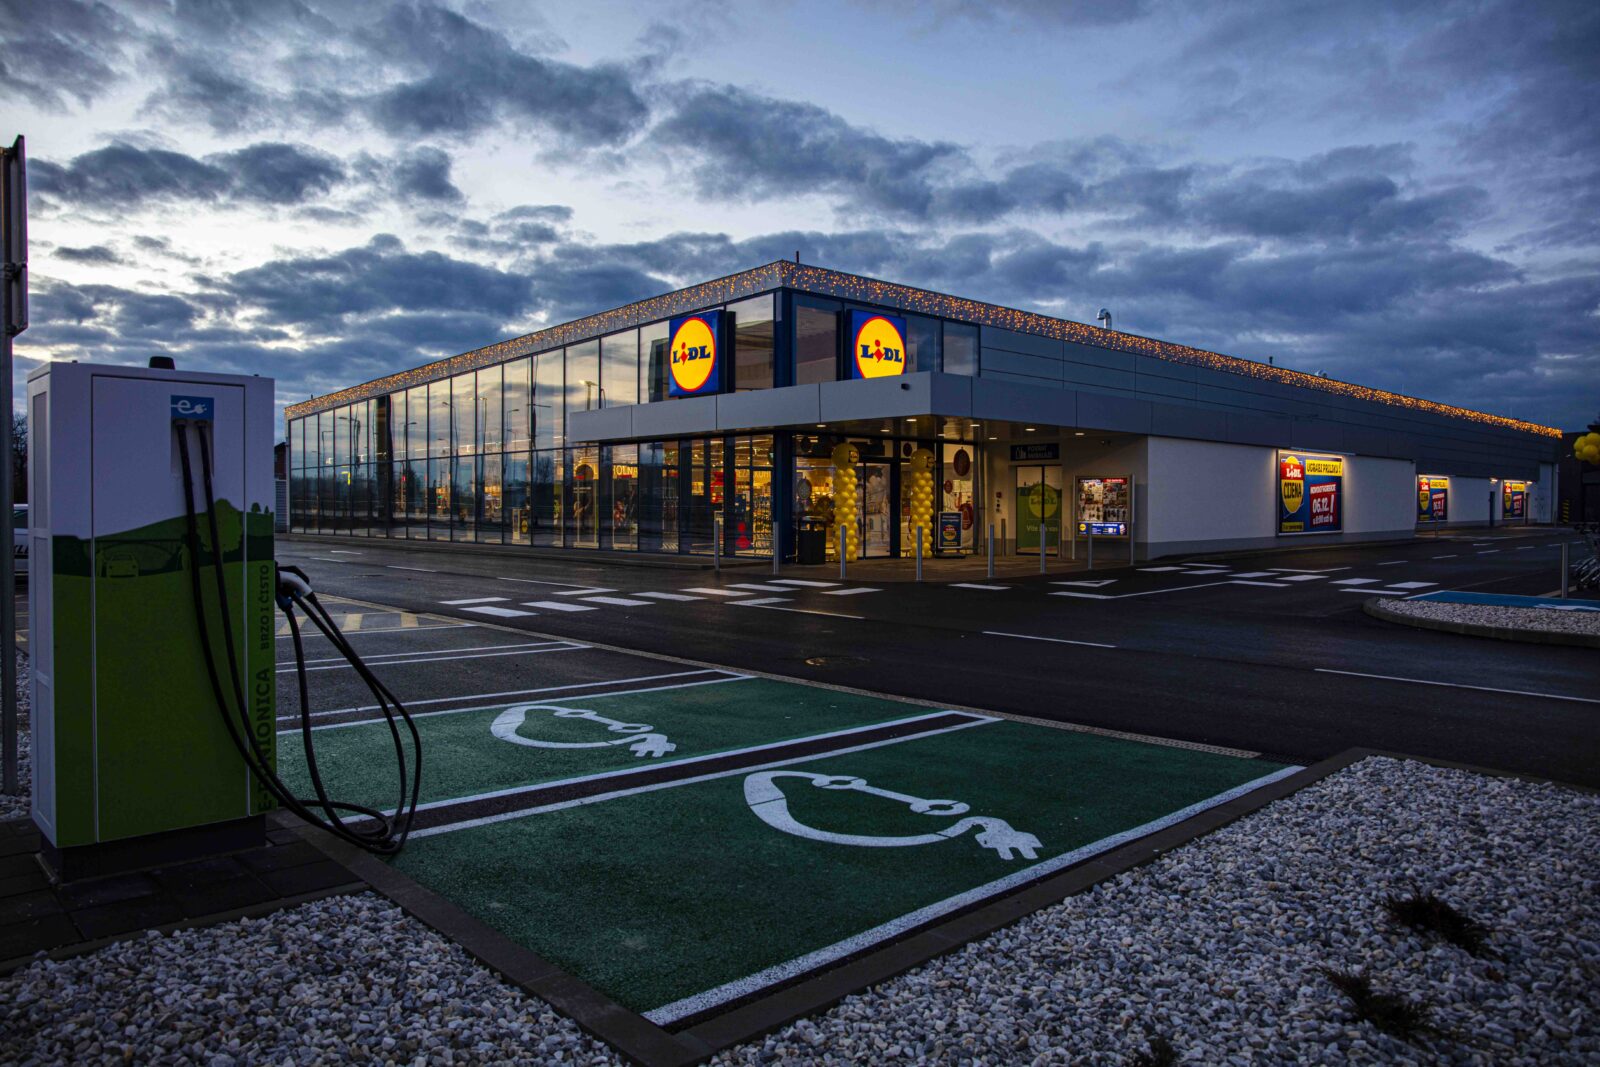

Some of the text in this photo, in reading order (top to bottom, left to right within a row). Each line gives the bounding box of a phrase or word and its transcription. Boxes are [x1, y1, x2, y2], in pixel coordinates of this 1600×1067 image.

[673, 341, 711, 366] LIDL
[860, 339, 903, 364] LIDL
[258, 564, 269, 604] ČISTO
[260, 615, 270, 650] BRZO
